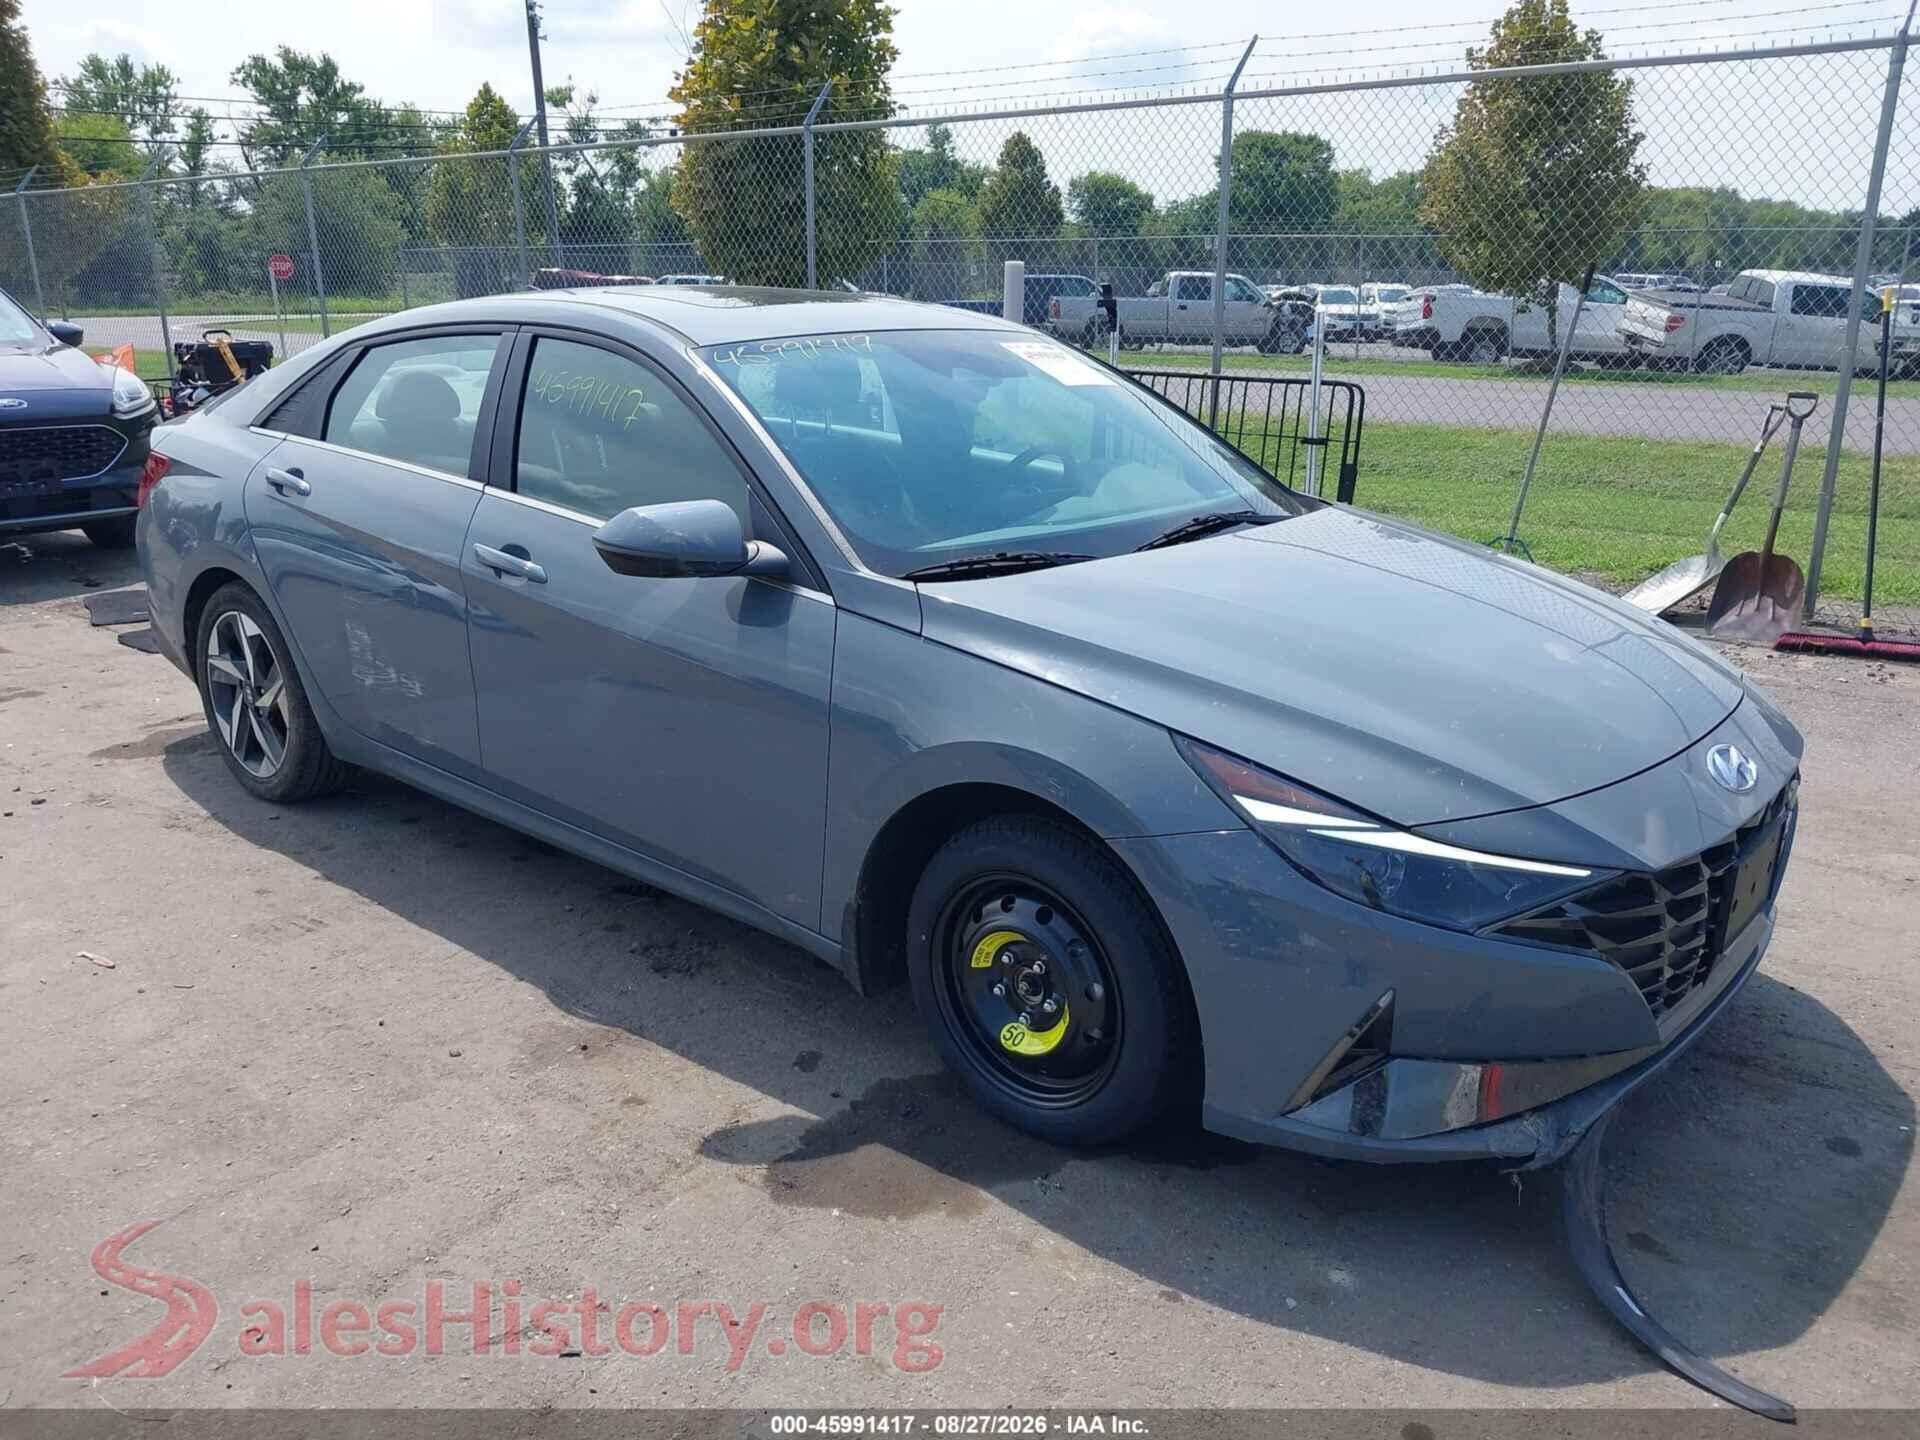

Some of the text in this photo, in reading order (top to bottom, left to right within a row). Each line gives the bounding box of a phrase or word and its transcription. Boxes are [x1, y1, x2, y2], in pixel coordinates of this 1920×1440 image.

[270, 261, 291, 271] STOP
[535, 369, 643, 431] 45991417
[1002, 1025, 1026, 1047] 50
